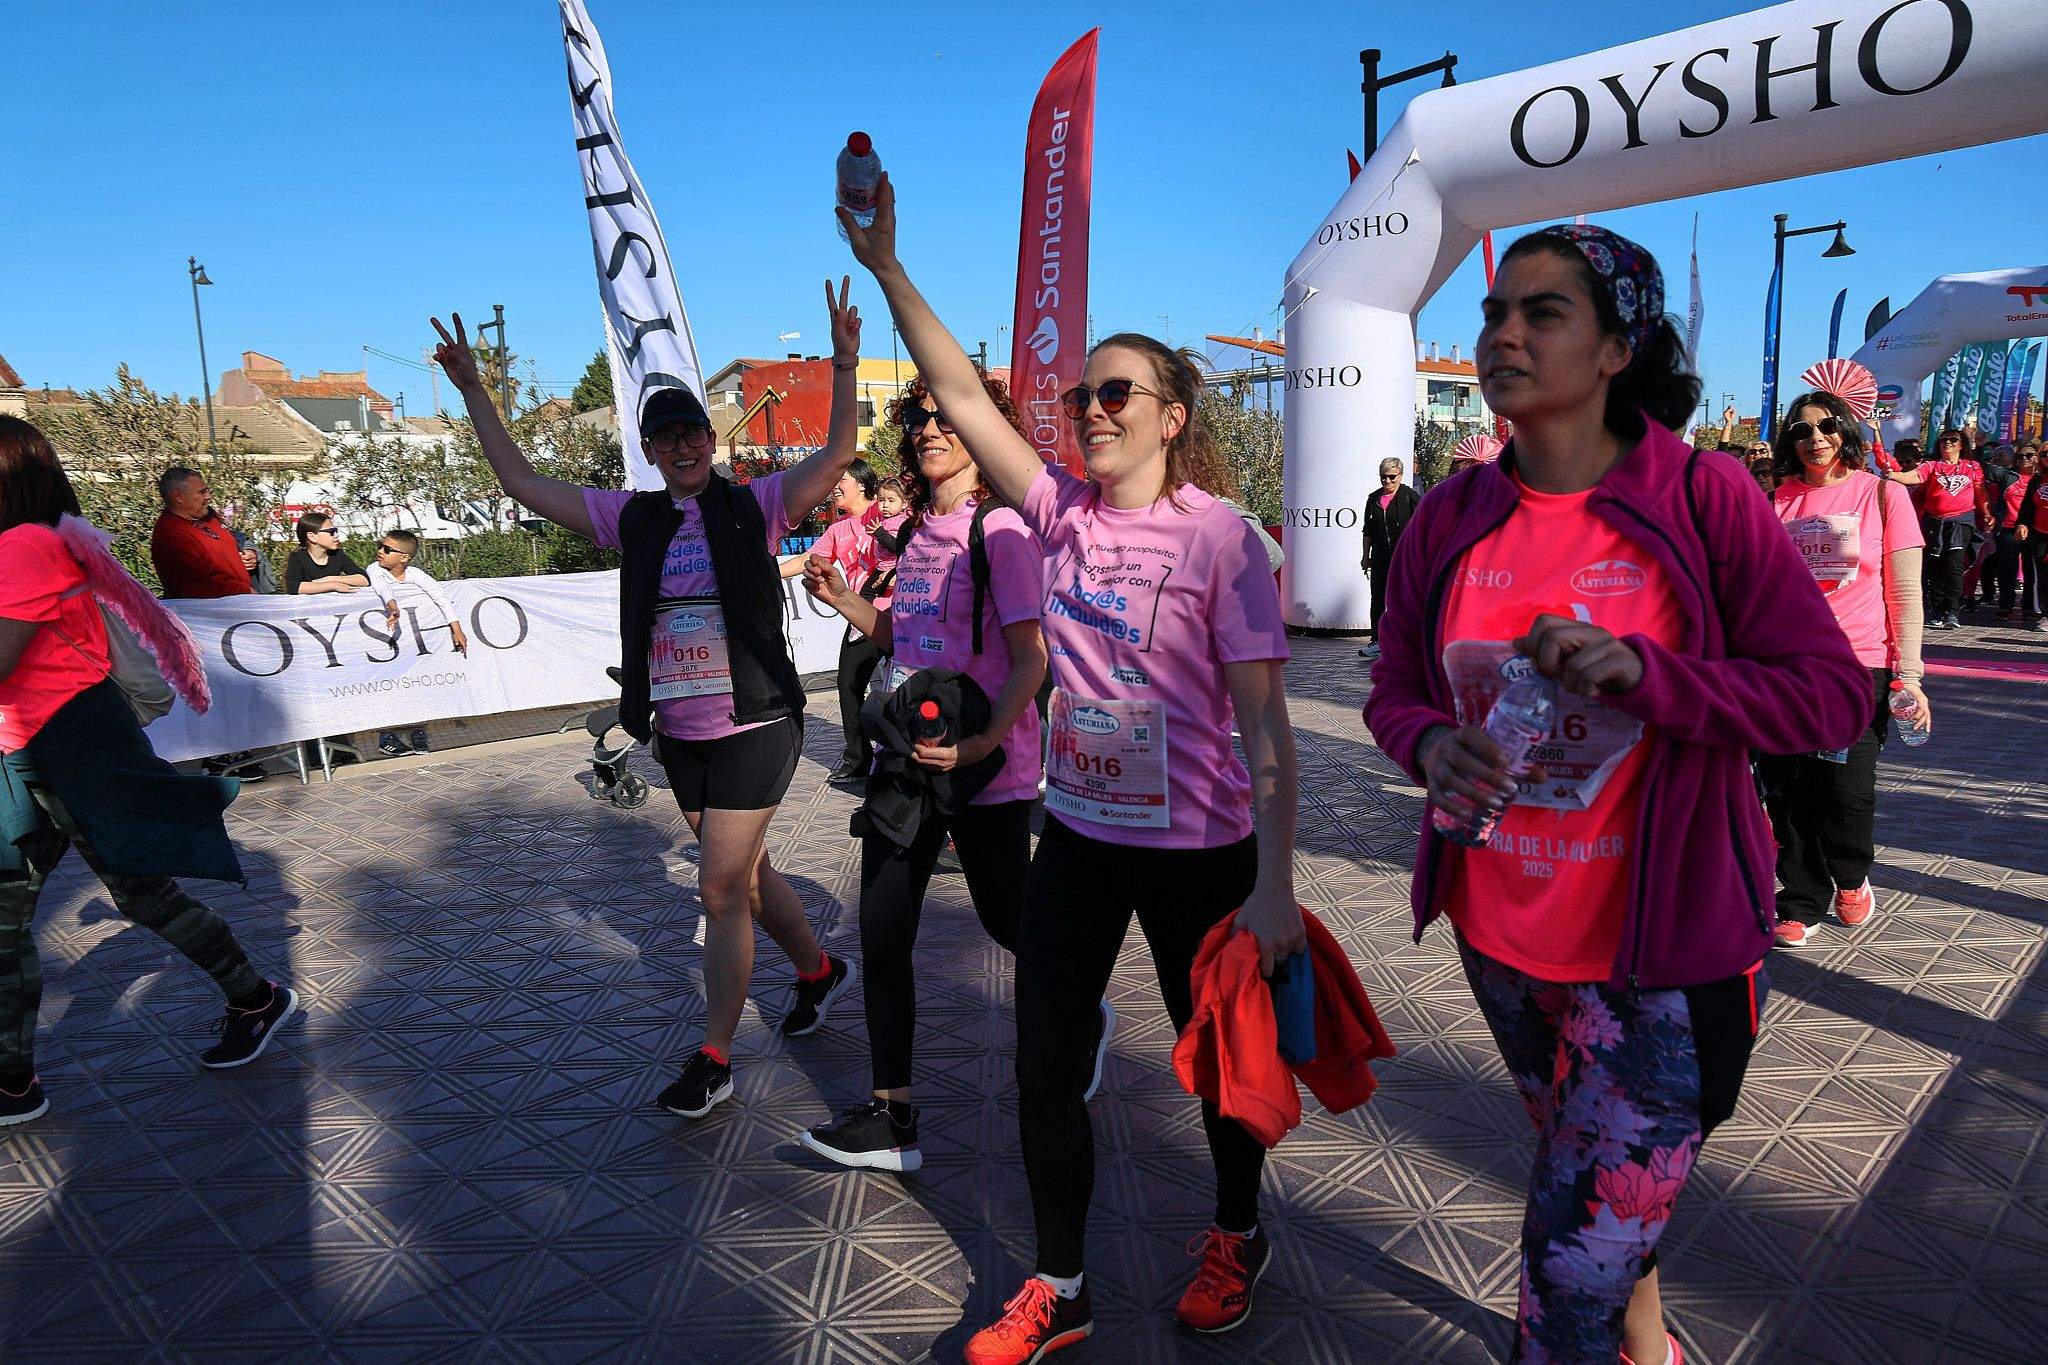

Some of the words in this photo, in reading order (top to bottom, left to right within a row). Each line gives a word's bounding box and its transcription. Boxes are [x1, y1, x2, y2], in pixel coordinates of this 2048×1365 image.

[1510, 0, 1973, 168] OYSHO
[1035, 107, 1071, 309] Santander
[1319, 212, 1409, 246] OYSHO
[1284, 365, 1361, 392] OYSHO
[1979, 350, 2006, 434] Batiste
[1802, 543, 1832, 556] 016
[931, 567, 946, 575] con
[1126, 563, 1142, 572] un
[898, 577, 931, 594] Tod@s
[1128, 577, 1152, 588] con
[1576, 574, 1641, 588] ASTURIANA
[221, 595, 529, 677] OYSHO
[673, 645, 710, 663] 016
[328, 671, 467, 699] WWW.OYSHO.COM
[1073, 715, 1116, 731] ASTURIANA
[1075, 752, 1122, 778] 016
[1085, 778, 1106, 790] 4390
[1109, 809, 1152, 821] Santander
[1519, 834, 1541, 856] DE
[1545, 838, 1566, 860] LA
[1522, 859, 1554, 879] 2025
